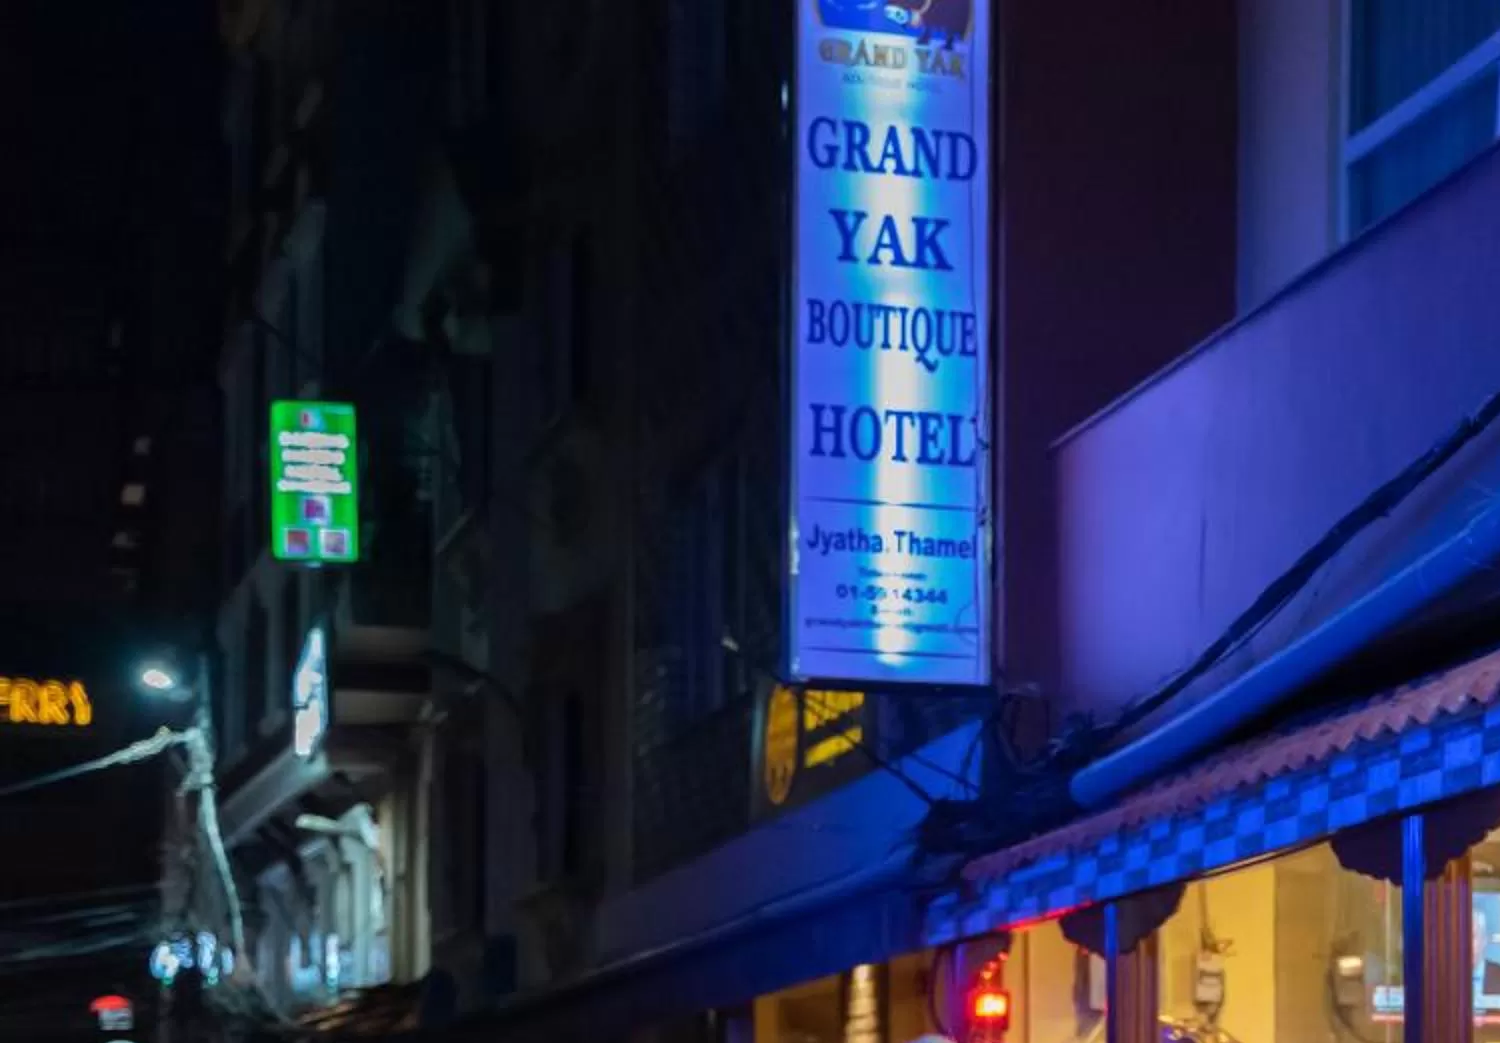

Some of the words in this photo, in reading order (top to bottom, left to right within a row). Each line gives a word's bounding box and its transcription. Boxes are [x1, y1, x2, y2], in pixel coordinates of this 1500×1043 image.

[807, 116, 978, 181] GRAND
[828, 208, 953, 272] YAK
[806, 298, 977, 373] BOUTIQUE
[809, 403, 977, 467] HOTEL
[893, 529, 977, 560] Thamel
